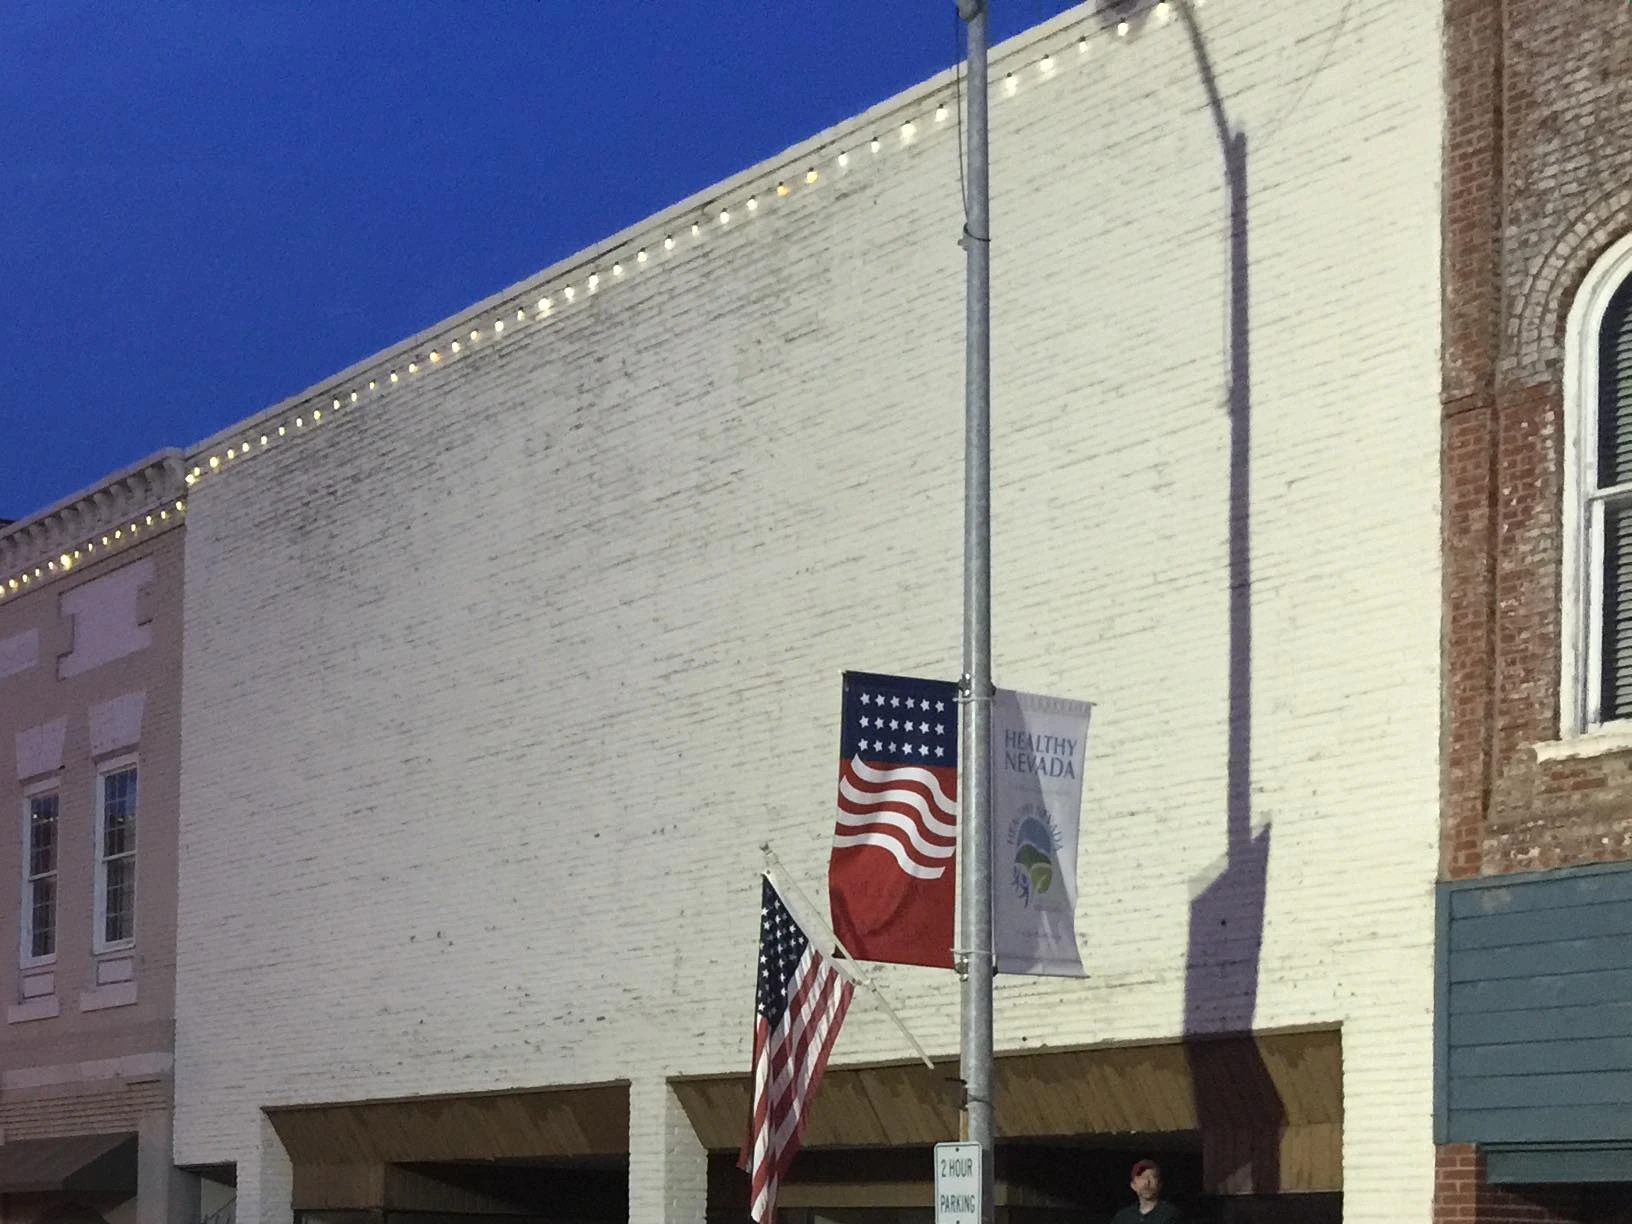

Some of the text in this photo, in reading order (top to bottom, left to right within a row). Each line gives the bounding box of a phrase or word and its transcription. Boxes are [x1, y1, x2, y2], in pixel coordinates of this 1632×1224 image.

[1004, 728, 1079, 757] HEALTHY
[1004, 751, 1076, 780] NEVADA
[940, 1158, 973, 1178] 2 HOUR
[940, 1194, 976, 1214] PARKING
